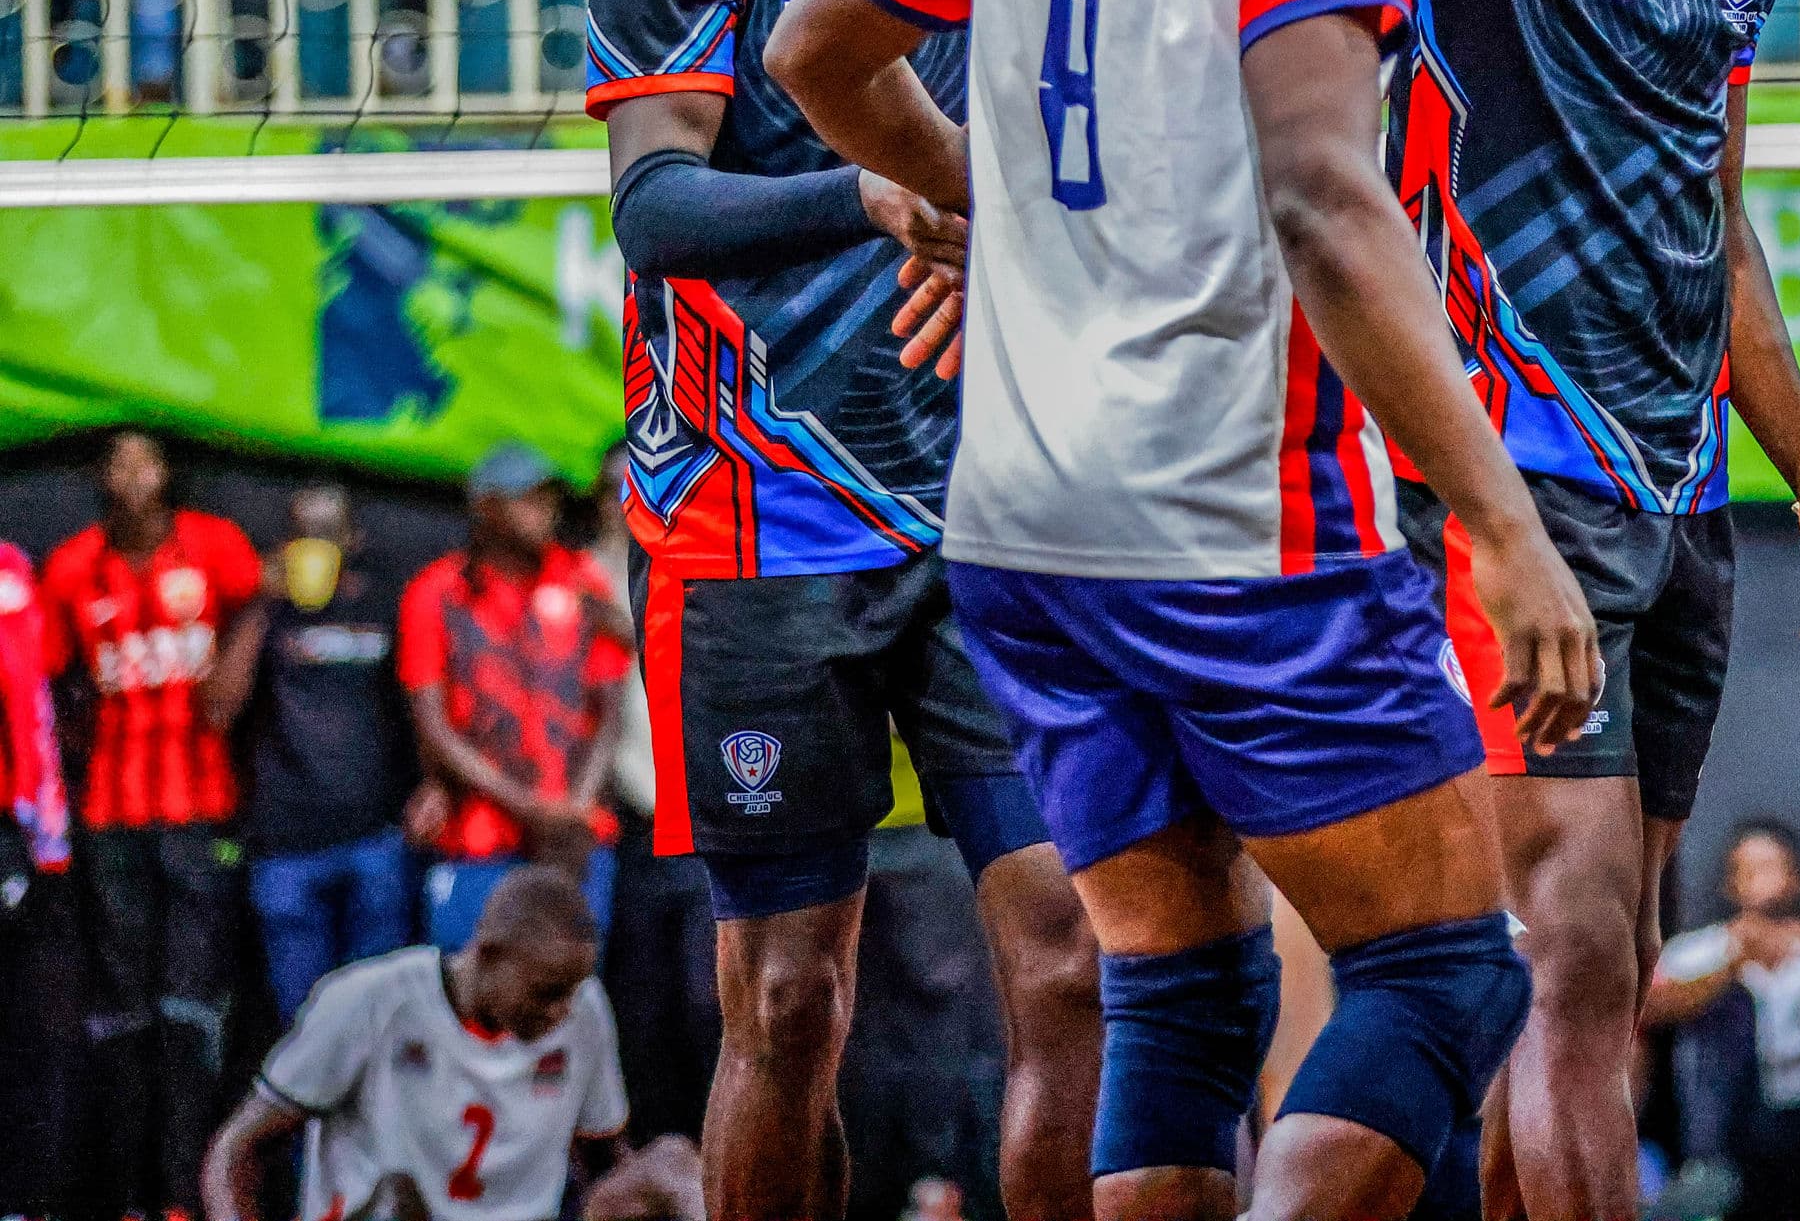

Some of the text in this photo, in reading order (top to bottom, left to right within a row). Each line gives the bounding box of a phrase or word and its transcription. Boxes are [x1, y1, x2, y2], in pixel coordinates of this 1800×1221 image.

[728, 792, 765, 803] CHEMA
[745, 803, 770, 815] JUJA
[447, 1103, 494, 1201] 2
